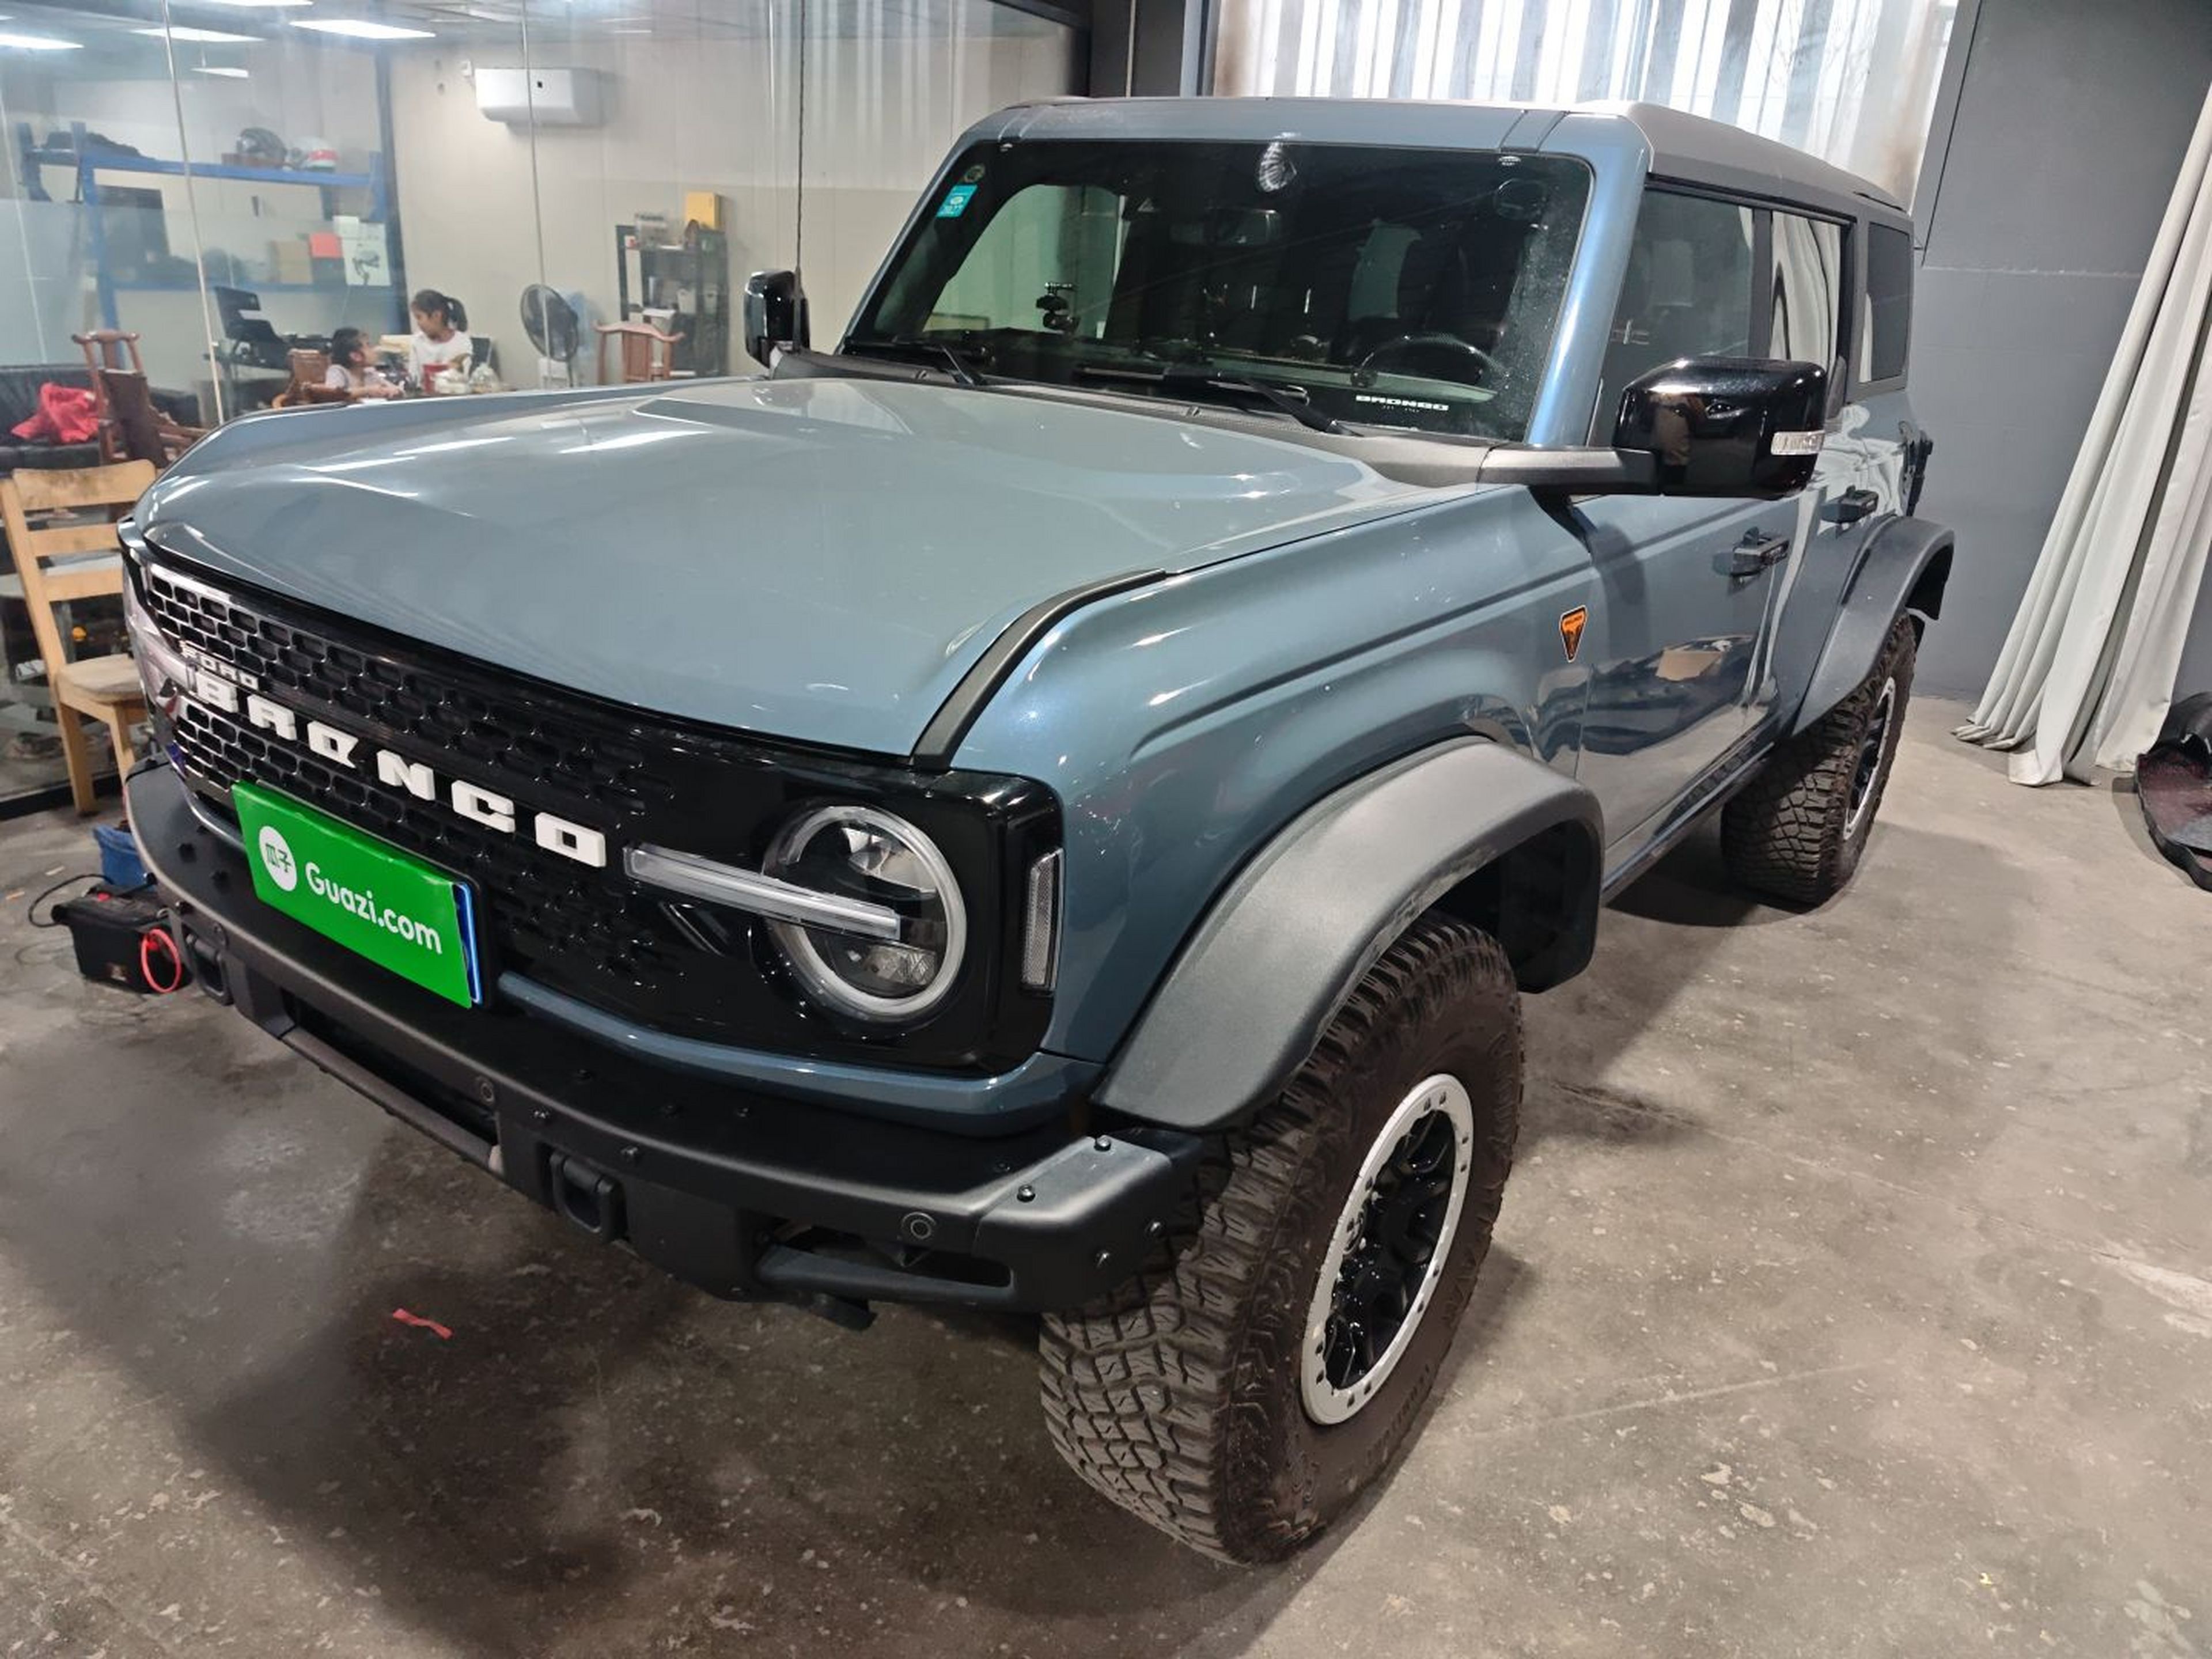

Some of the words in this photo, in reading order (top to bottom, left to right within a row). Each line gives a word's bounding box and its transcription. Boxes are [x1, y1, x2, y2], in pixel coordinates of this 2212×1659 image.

[180, 641, 259, 691] FORD
[192, 669, 607, 868] BRONCO
[265, 843, 291, 873] 瓜子
[305, 862, 442, 955] Guazi.com
